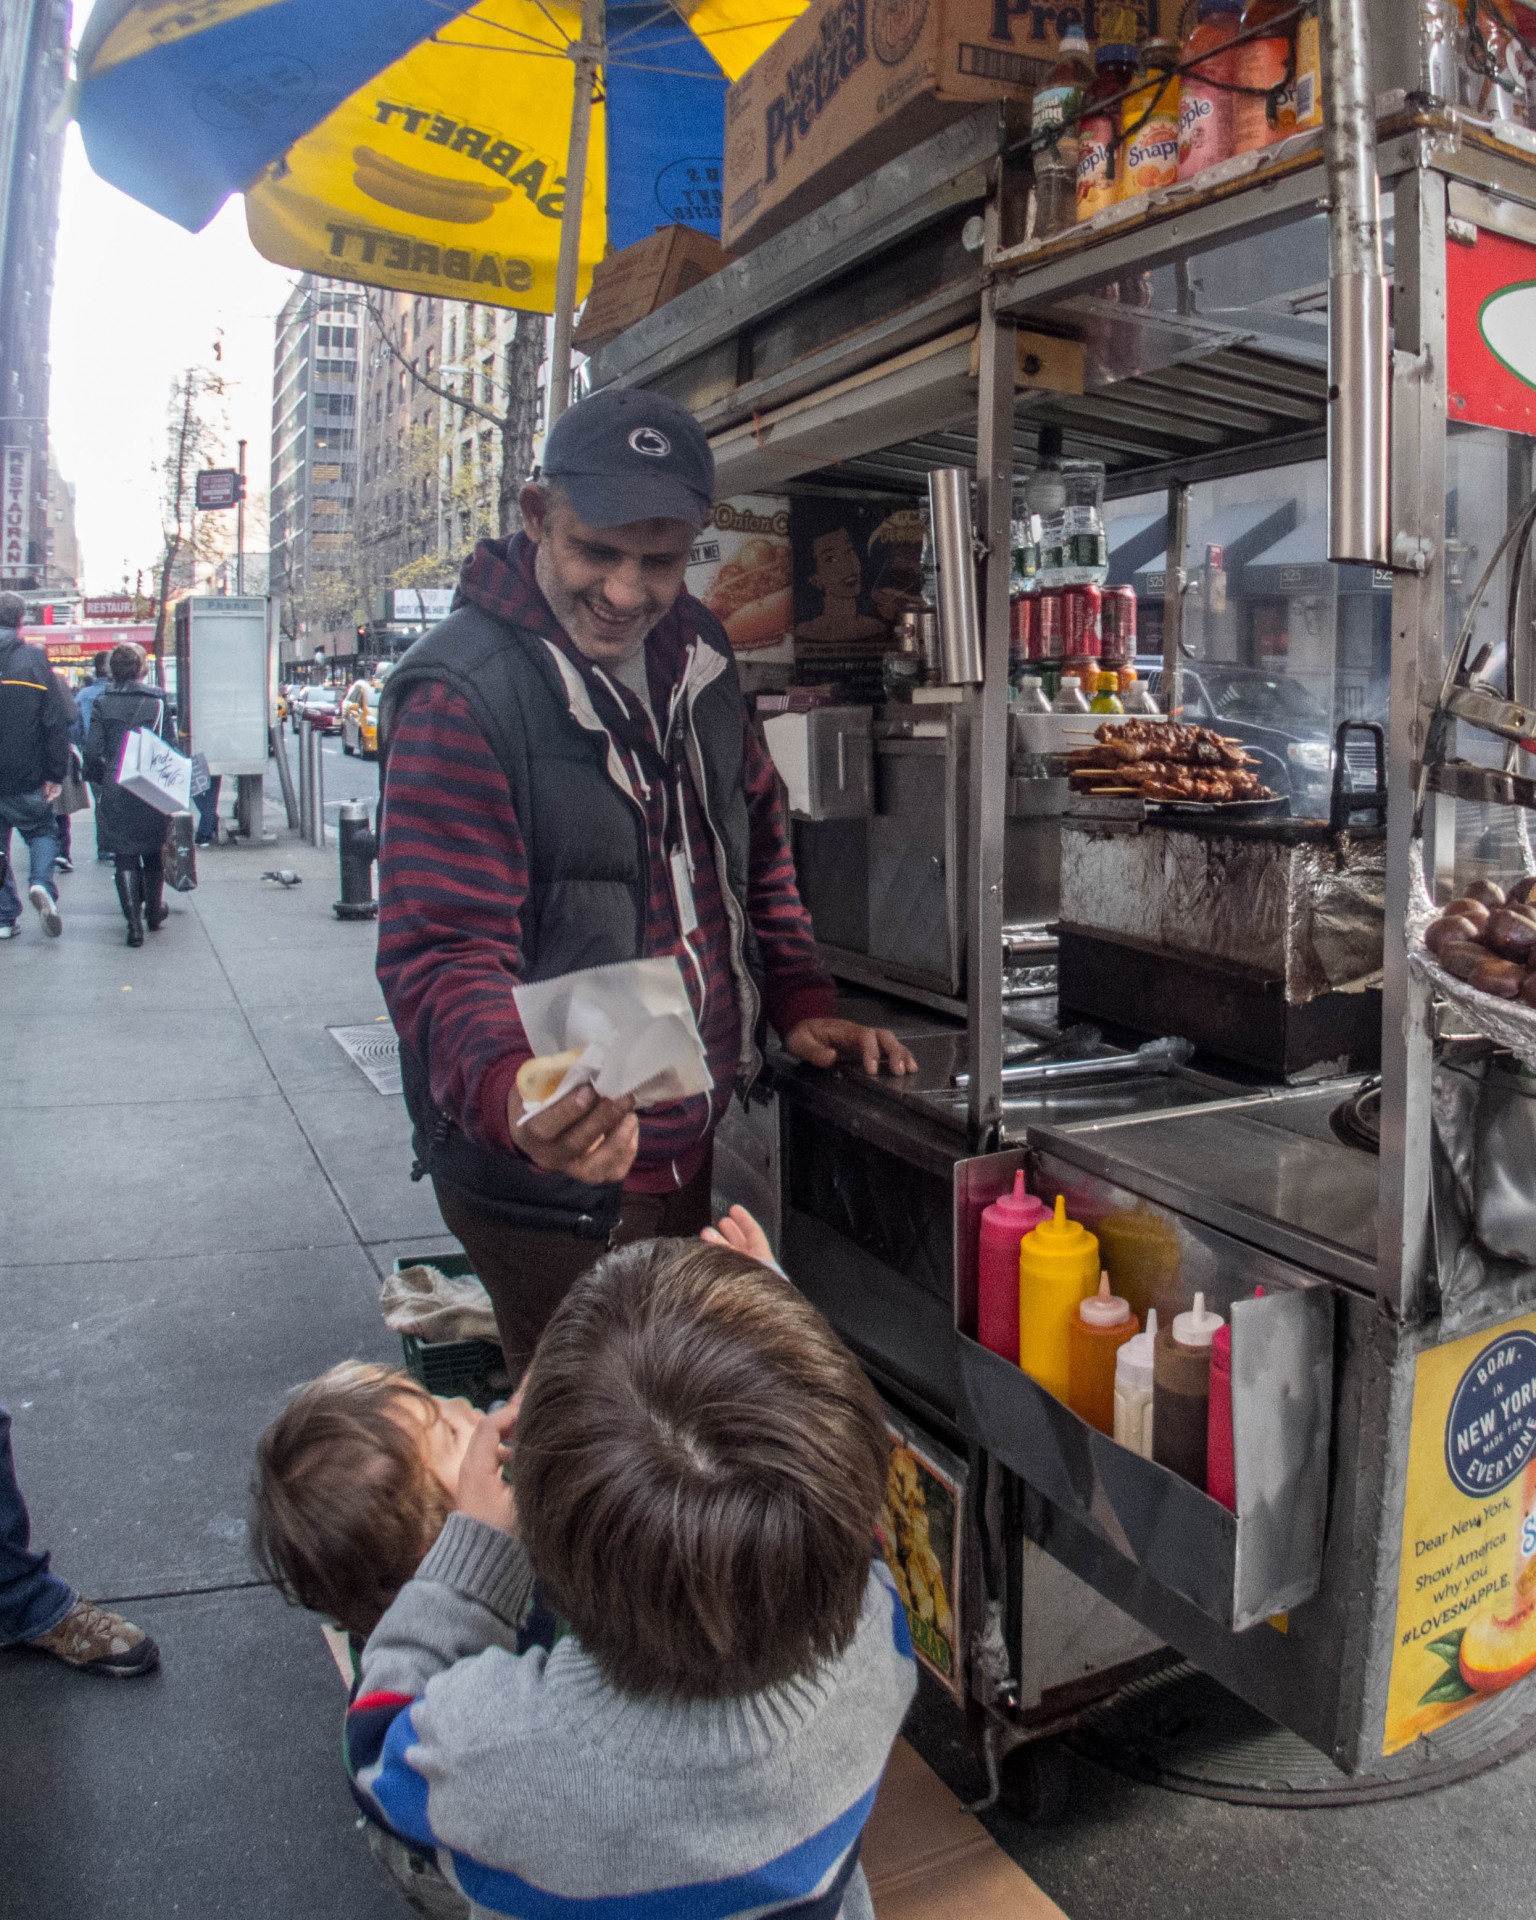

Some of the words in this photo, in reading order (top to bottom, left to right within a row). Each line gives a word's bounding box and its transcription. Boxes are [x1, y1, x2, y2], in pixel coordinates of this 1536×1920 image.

[1179, 99, 1212, 134] pple
[1128, 140, 1178, 167] Snap
[8, 450, 24, 578] RESTAURANT
[86, 601, 138, 614] RESTAURA
[1477, 1346, 1516, 1386] BORN
[1493, 1382, 1504, 1398] IN
[1456, 1408, 1495, 1456] NEW
[1466, 1416, 1536, 1483] EVERYONE
[1482, 1431, 1505, 1456] MADE
[1507, 1417, 1523, 1436] FOR
[1414, 1530, 1447, 1557] Dear
[1450, 1517, 1478, 1538] New
[1414, 1563, 1452, 1592] Show
[1456, 1531, 1508, 1571] America
[1433, 1580, 1461, 1605] why
[1463, 1564, 1488, 1588] you
